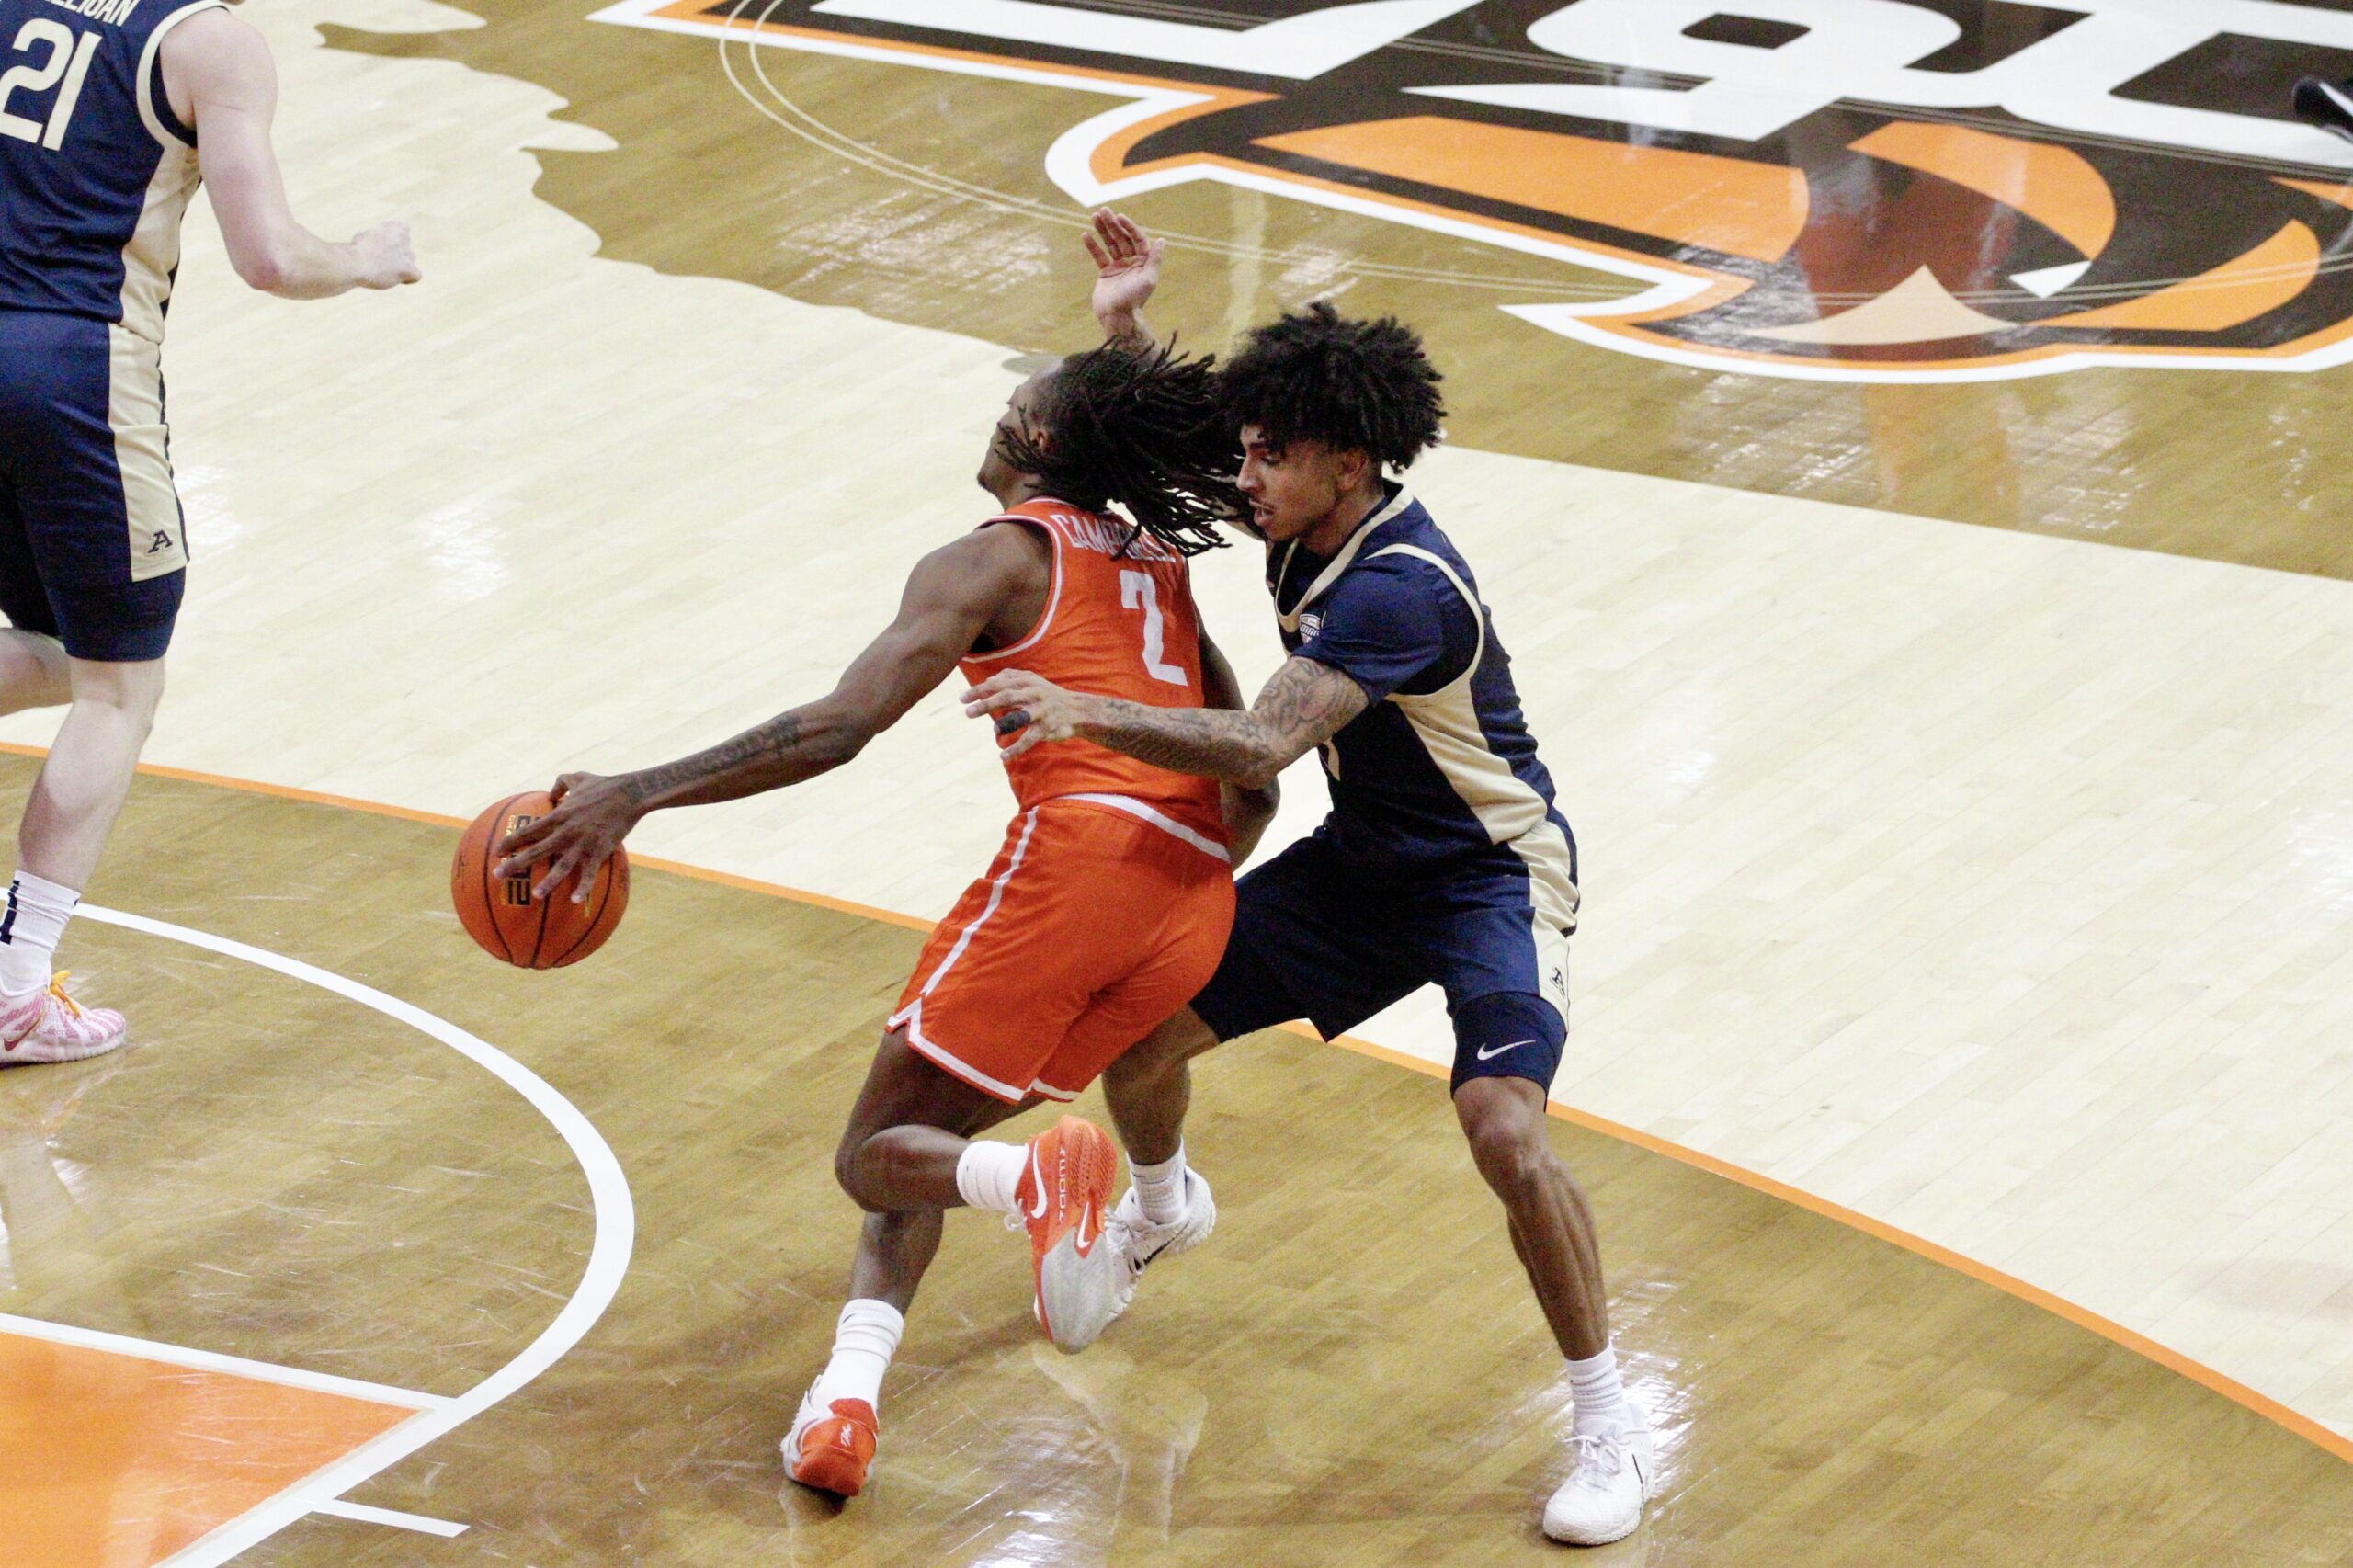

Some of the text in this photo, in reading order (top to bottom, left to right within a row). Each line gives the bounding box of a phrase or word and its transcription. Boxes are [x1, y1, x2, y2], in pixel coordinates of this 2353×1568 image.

[0, 17, 103, 152] 21
[147, 529, 173, 554] A
[1119, 569, 1189, 687] 2
